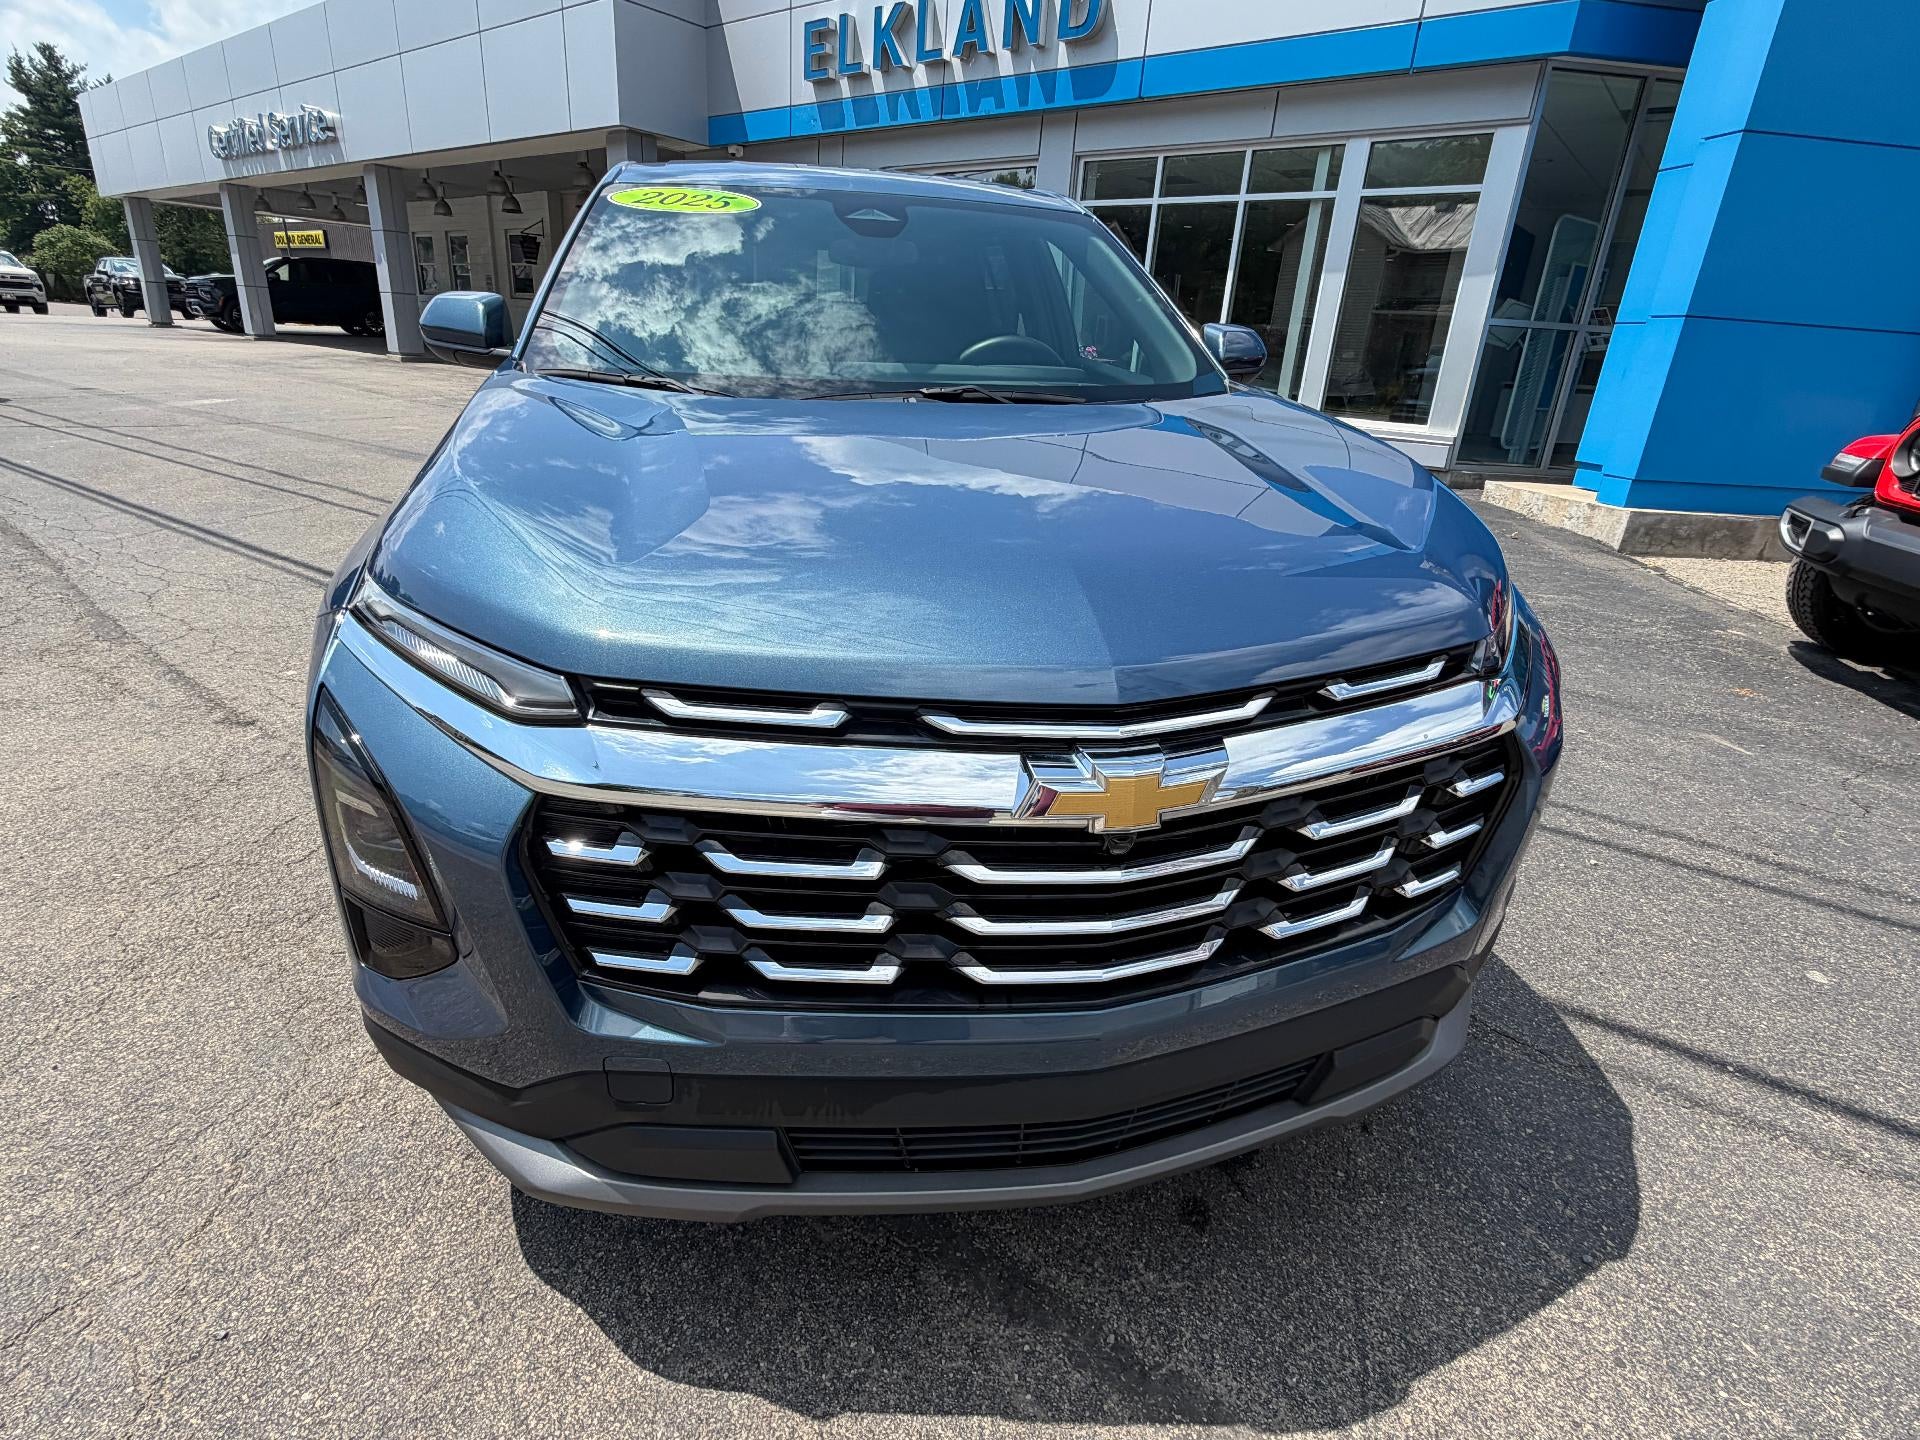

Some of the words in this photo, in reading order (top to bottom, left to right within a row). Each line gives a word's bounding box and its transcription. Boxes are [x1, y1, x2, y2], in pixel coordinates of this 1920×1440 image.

[803, 0, 1108, 81] ELKLAND
[207, 112, 267, 159] Certified
[267, 104, 336, 149] Service
[631, 191, 738, 210] 2025
[275, 234, 297, 246] DOLAR
[296, 233, 323, 246] GENERAL
